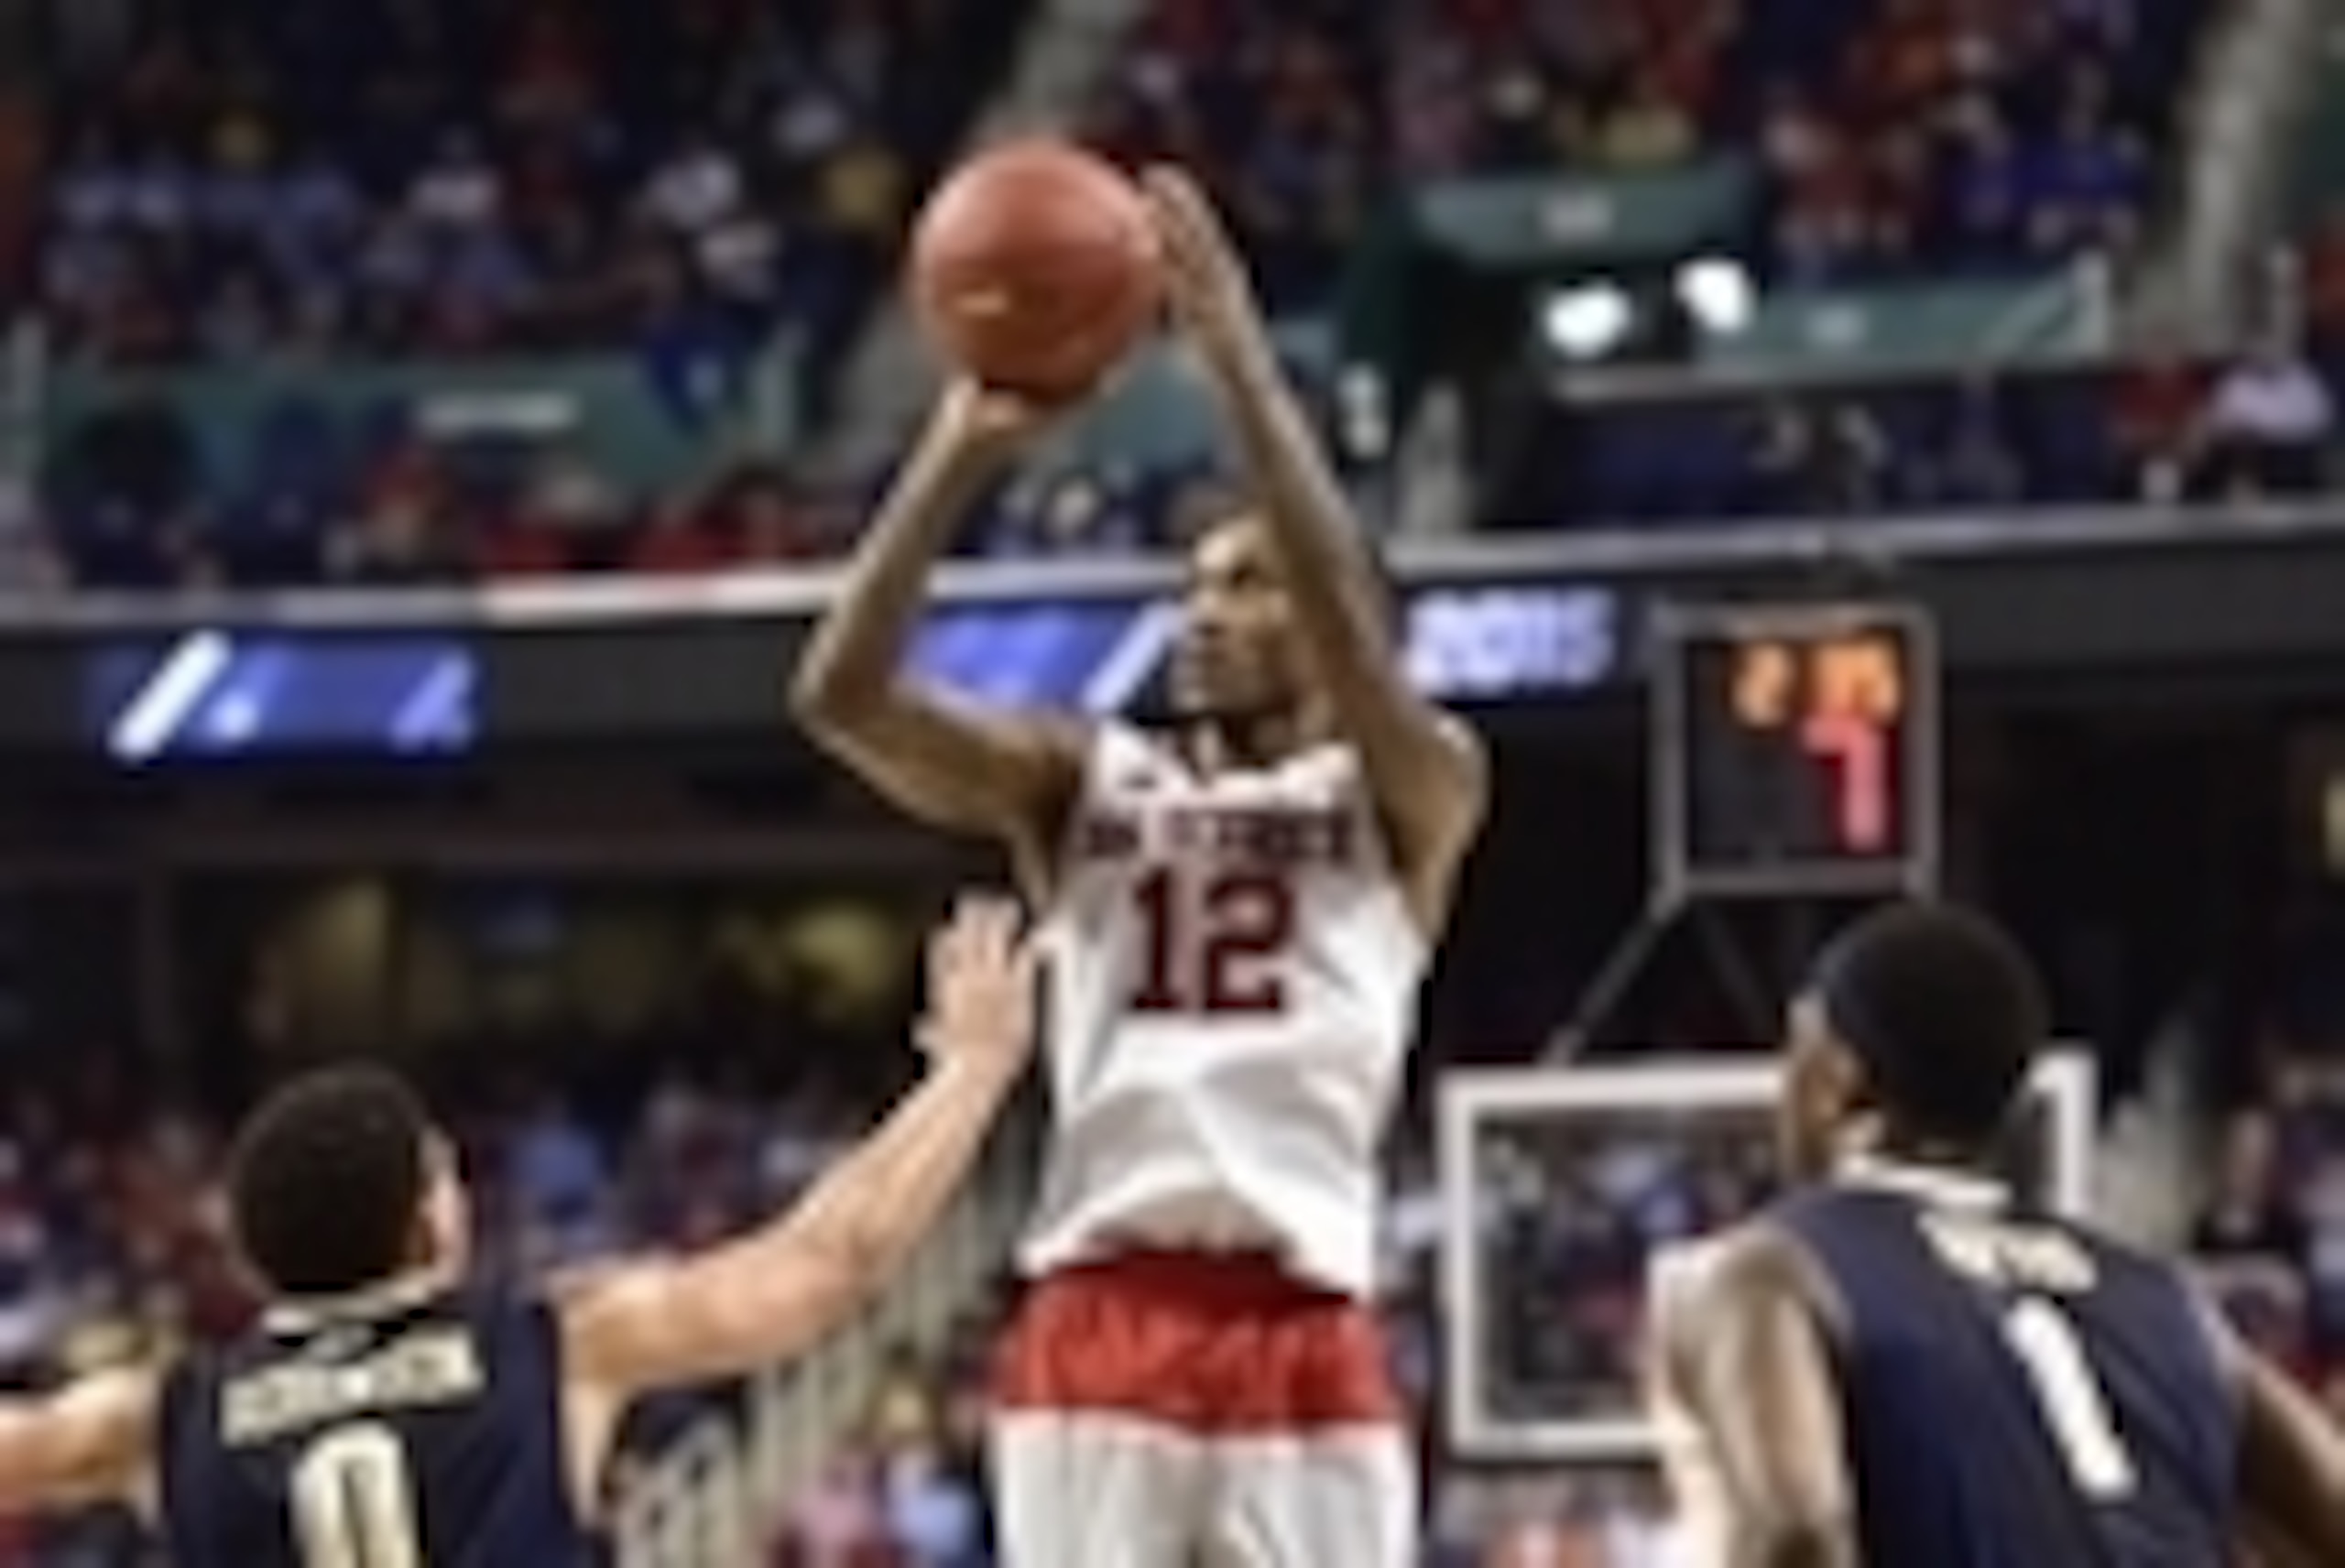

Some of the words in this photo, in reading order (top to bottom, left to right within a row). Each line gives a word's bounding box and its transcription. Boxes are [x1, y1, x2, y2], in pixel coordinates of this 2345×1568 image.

[1130, 861, 1296, 1015] 12
[2002, 1290, 2134, 1502] 1
[291, 1420, 418, 1568] 0
